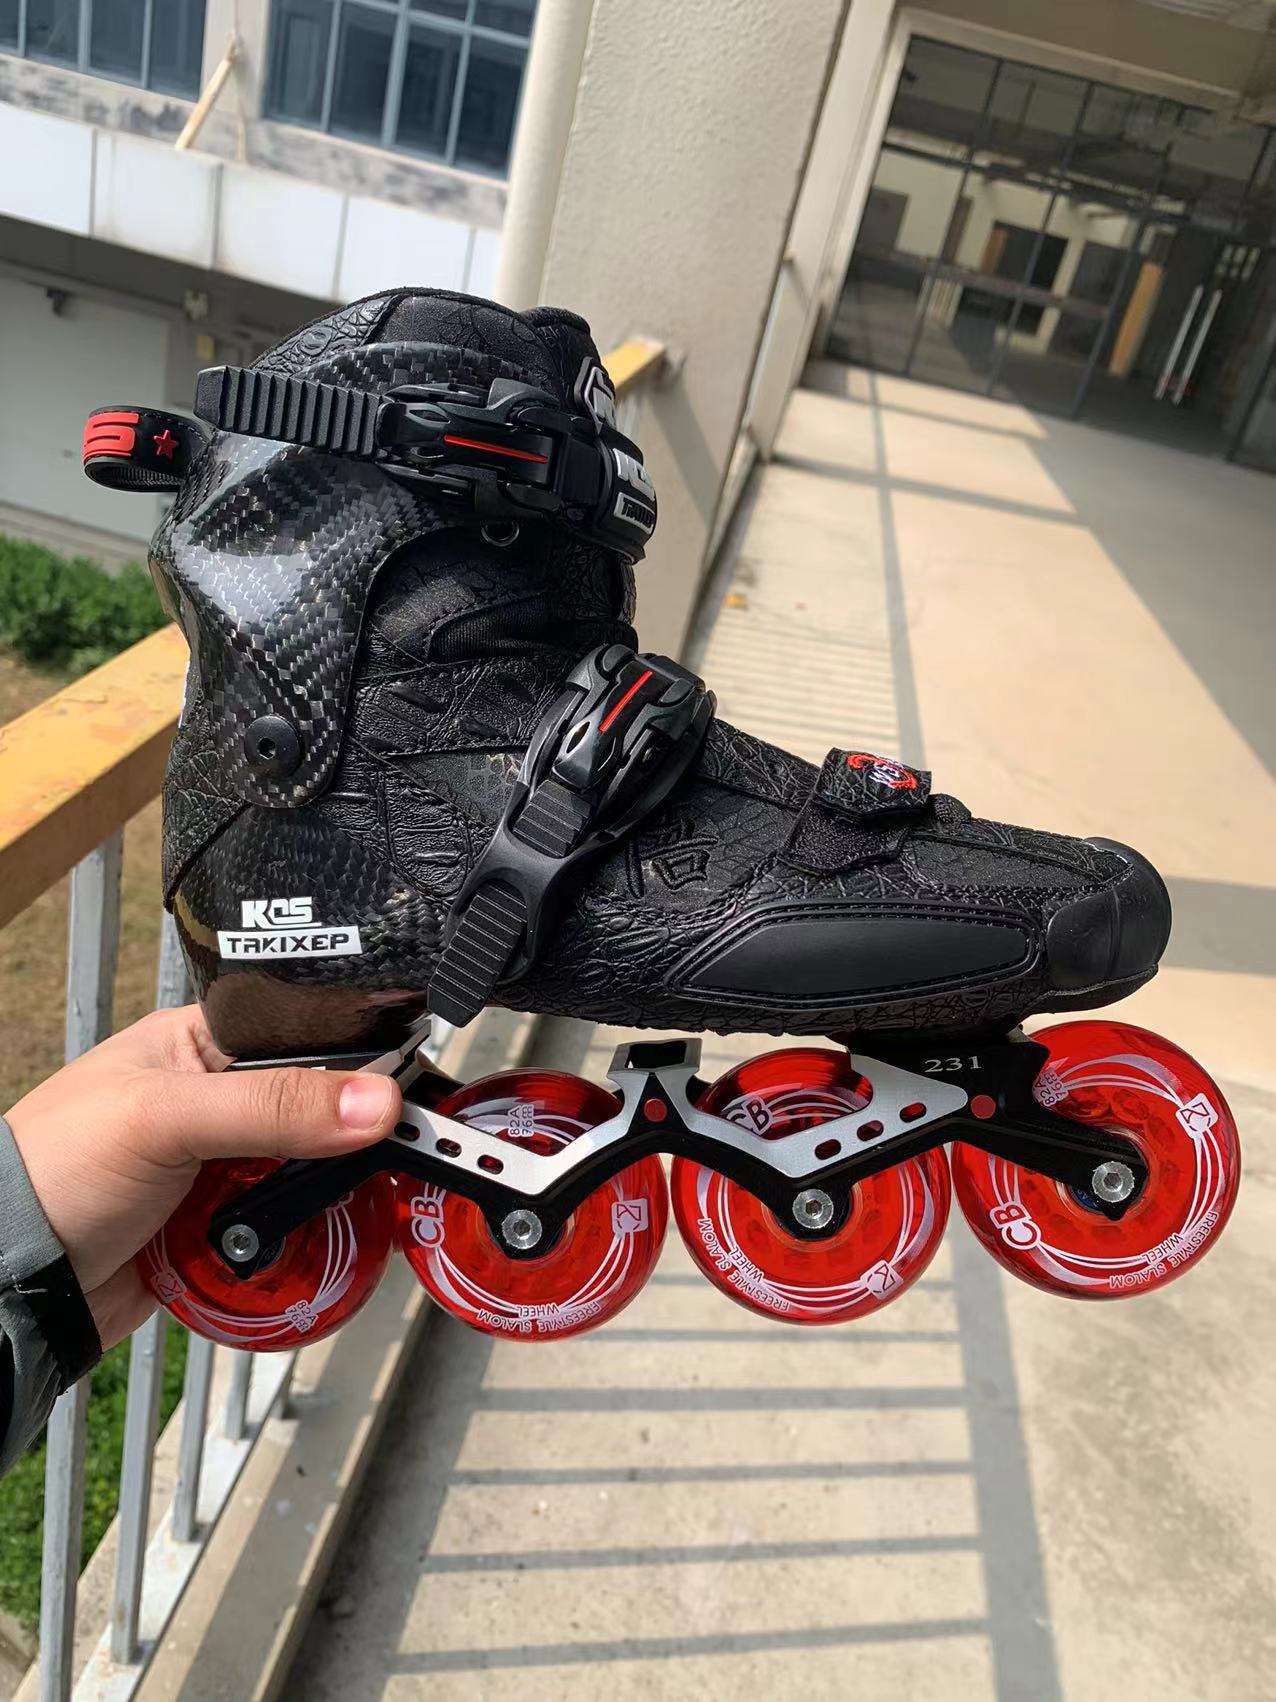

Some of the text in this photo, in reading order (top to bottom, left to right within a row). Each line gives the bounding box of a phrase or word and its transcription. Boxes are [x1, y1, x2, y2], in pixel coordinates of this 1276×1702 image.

[924, 1055, 983, 1073] 231
[509, 1104, 521, 1136] 82A
[413, 1198, 443, 1246] CB
[992, 1203, 1039, 1248] CB
[698, 1218, 790, 1312] FREESTYLE SLALOM
[730, 1246, 763, 1282] WHEEL
[1109, 1211, 1218, 1288] FREESTYLE SLALOM
[1142, 1233, 1184, 1263] WHEEL
[478, 1301, 601, 1332] FREESTYLE SLALOM
[518, 1303, 560, 1318] WHEEL
